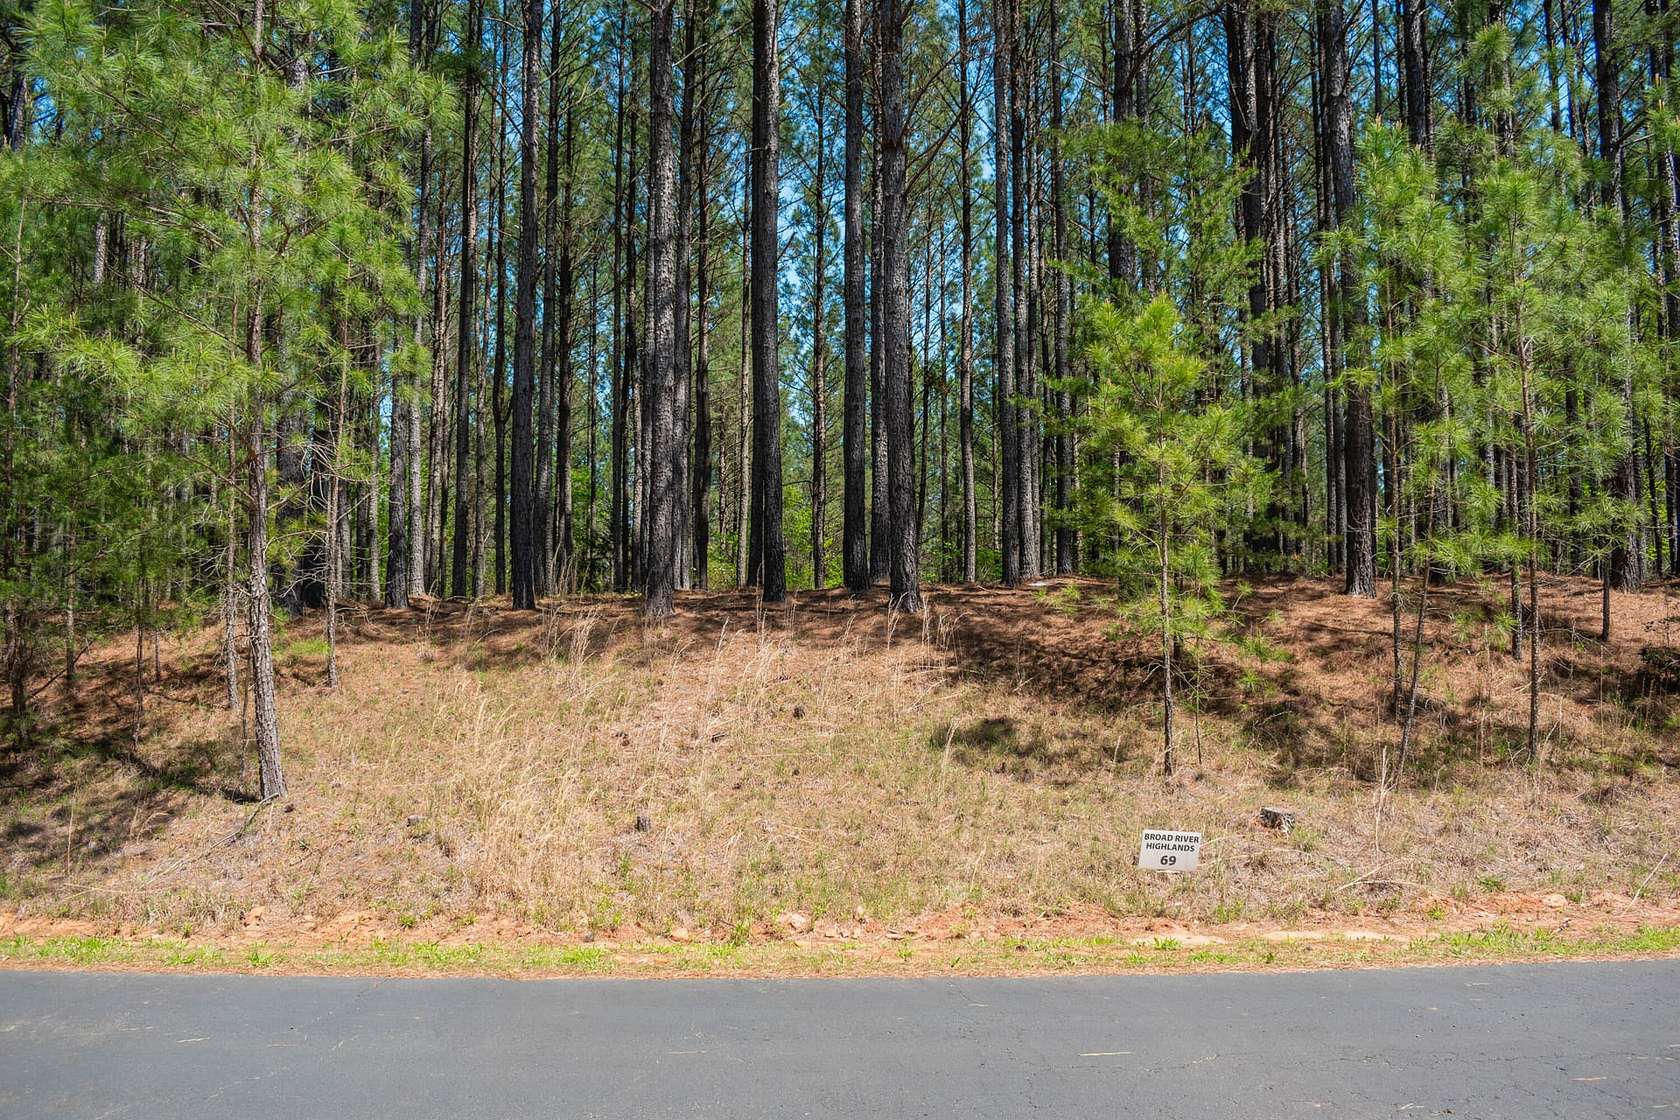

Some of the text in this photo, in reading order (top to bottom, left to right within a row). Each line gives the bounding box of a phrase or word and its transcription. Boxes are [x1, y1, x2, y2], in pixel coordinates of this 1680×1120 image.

[1144, 833, 1199, 843] BROAD RIVER
[1146, 842, 1195, 852] HIGHLANDS
[1160, 855, 1177, 866] 69
